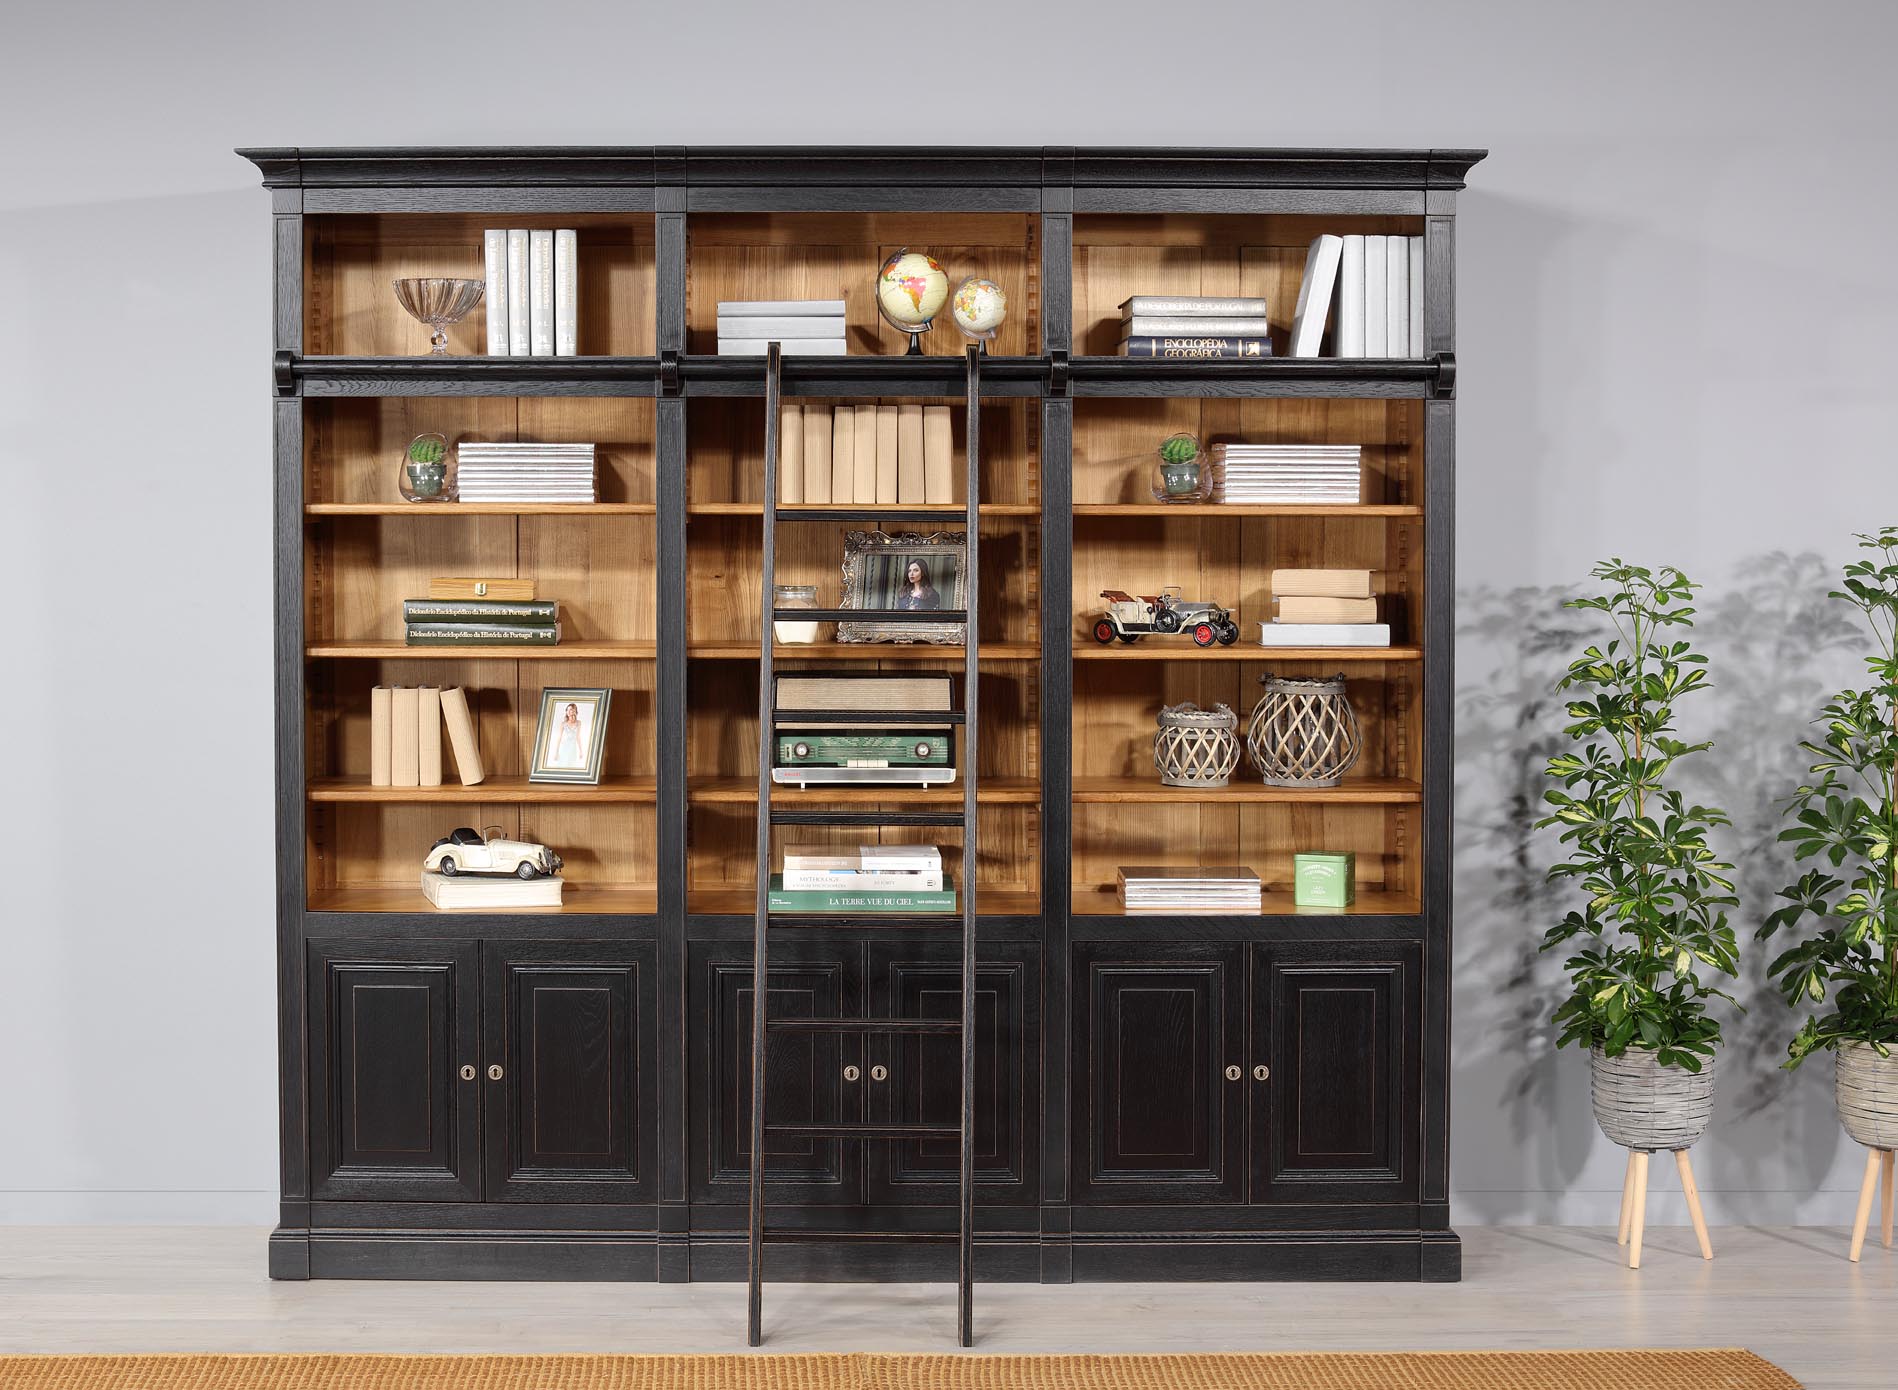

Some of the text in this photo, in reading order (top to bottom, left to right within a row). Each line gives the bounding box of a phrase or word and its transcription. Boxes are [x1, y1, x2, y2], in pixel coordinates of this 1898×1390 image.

[1164, 338, 1228, 349] ENCICLOPÉDIA
[1164, 348, 1222, 357] GEOGRÁFICA
[508, 609, 532, 617] Portugal
[829, 897, 839, 905] LA
[841, 897, 866, 905] TERRE
[884, 898, 895, 906] DU
[896, 898, 914, 906] CIEL
